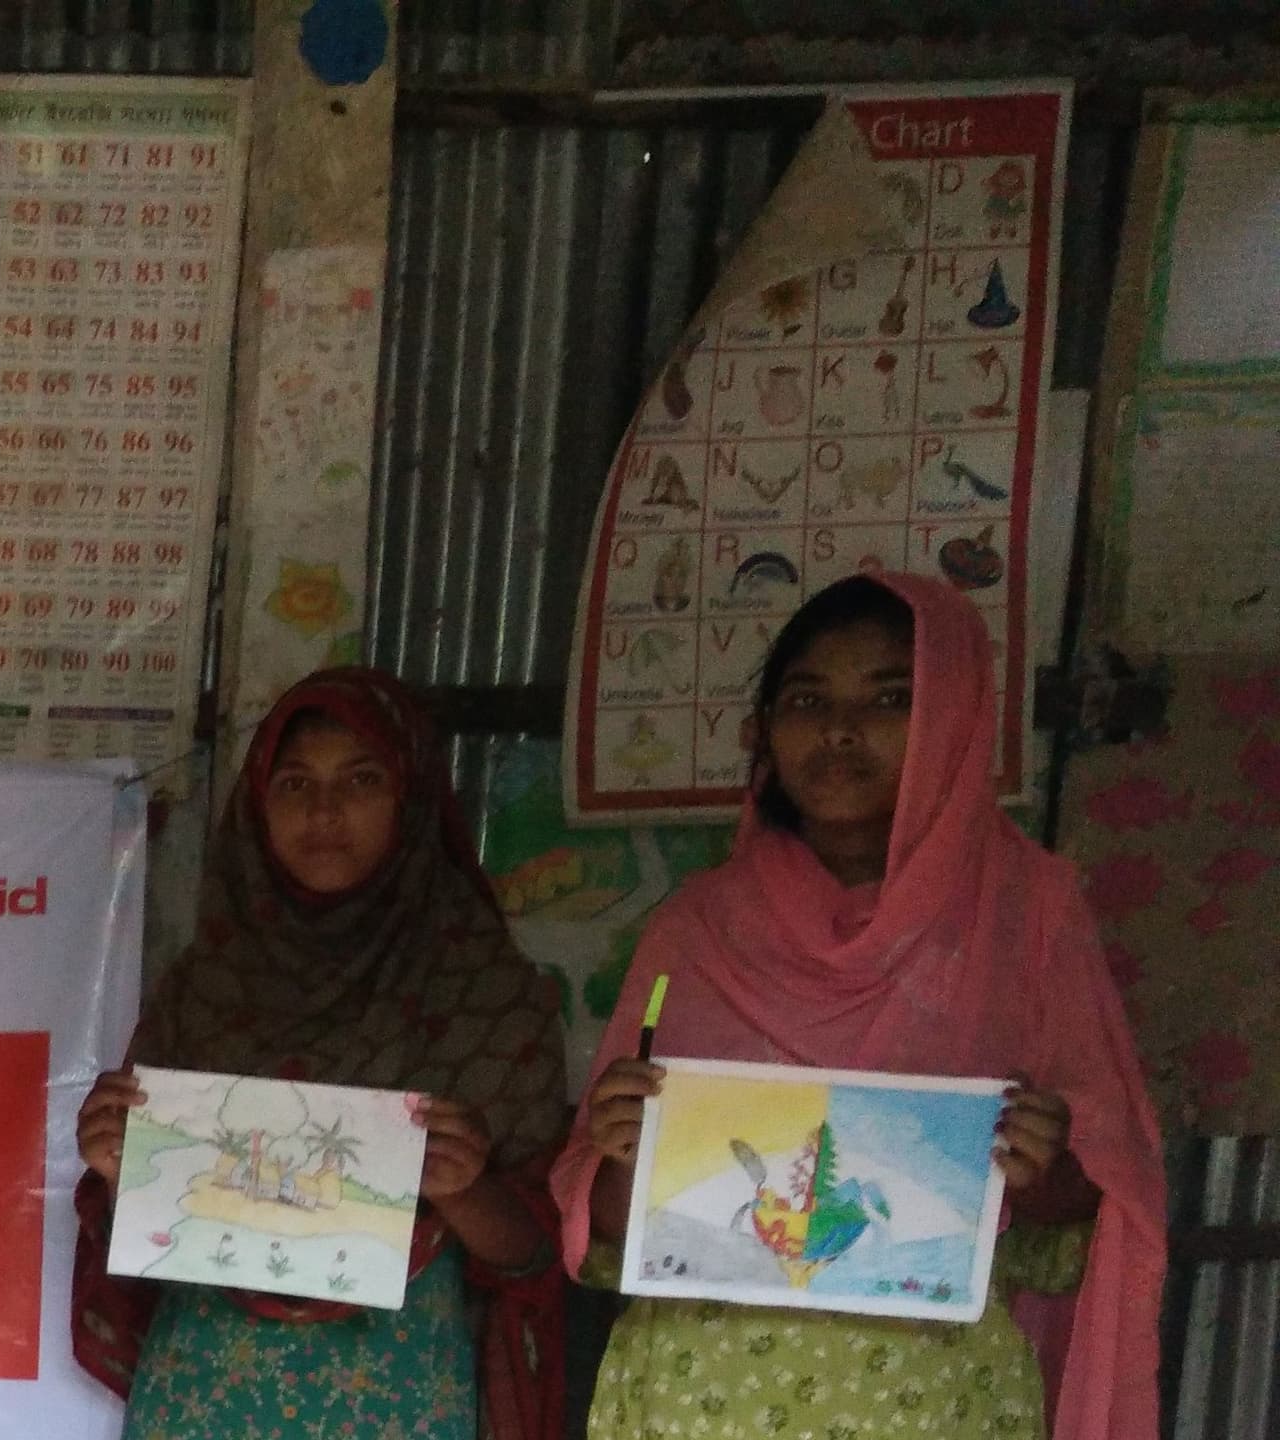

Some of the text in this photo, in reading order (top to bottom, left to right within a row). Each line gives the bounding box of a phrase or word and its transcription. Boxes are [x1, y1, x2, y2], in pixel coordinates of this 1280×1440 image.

[872, 112, 976, 149] Chart
[59, 143, 87, 165] 61
[106, 143, 129, 166] 71
[147, 144, 173, 167] 81
[191, 146, 215, 168] 91
[939, 163, 963, 194] D
[100, 203, 126, 226] 72
[142, 204, 169, 226] 82
[185, 204, 212, 227] 92
[94, 260, 120, 282] 73
[136, 261, 164, 283] 83
[180, 262, 208, 282] 93
[830, 260, 856, 290] G
[931, 255, 957, 285] H
[5, 316, 32, 337] 54
[90, 319, 115, 339] 74
[130, 320, 158, 342] 84
[173, 321, 201, 342] 94
[718, 360, 735, 391] J
[822, 356, 845, 387] K
[928, 353, 945, 382] L
[42, 373, 70, 393] 65
[86, 374, 112, 394] 75
[127, 375, 154, 395] 85
[169, 375, 197, 396] 95
[81, 429, 108, 451] 76
[122, 431, 150, 451] 86
[165, 431, 193, 453] 96
[921, 438, 943, 467] P
[626, 449, 650, 480] M
[713, 448, 737, 477] N
[816, 442, 843, 473] O
[77, 484, 103, 507] 77
[118, 487, 146, 508] 87
[160, 487, 188, 508] 97
[71, 541, 98, 563] 78
[112, 542, 140, 564] 88
[155, 543, 183, 565] 98
[716, 534, 740, 564] R
[814, 529, 835, 562] S
[915, 526, 940, 553] T
[24, 597, 52, 617] 69
[68, 597, 93, 618] 79
[107, 598, 135, 619] 89
[606, 631, 627, 659] U
[711, 624, 736, 653] V
[21, 648, 47, 670] 70
[60, 650, 88, 671] 80
[103, 651, 130, 672] 90
[142, 652, 176, 672] 100
[701, 708, 724, 737] Y
